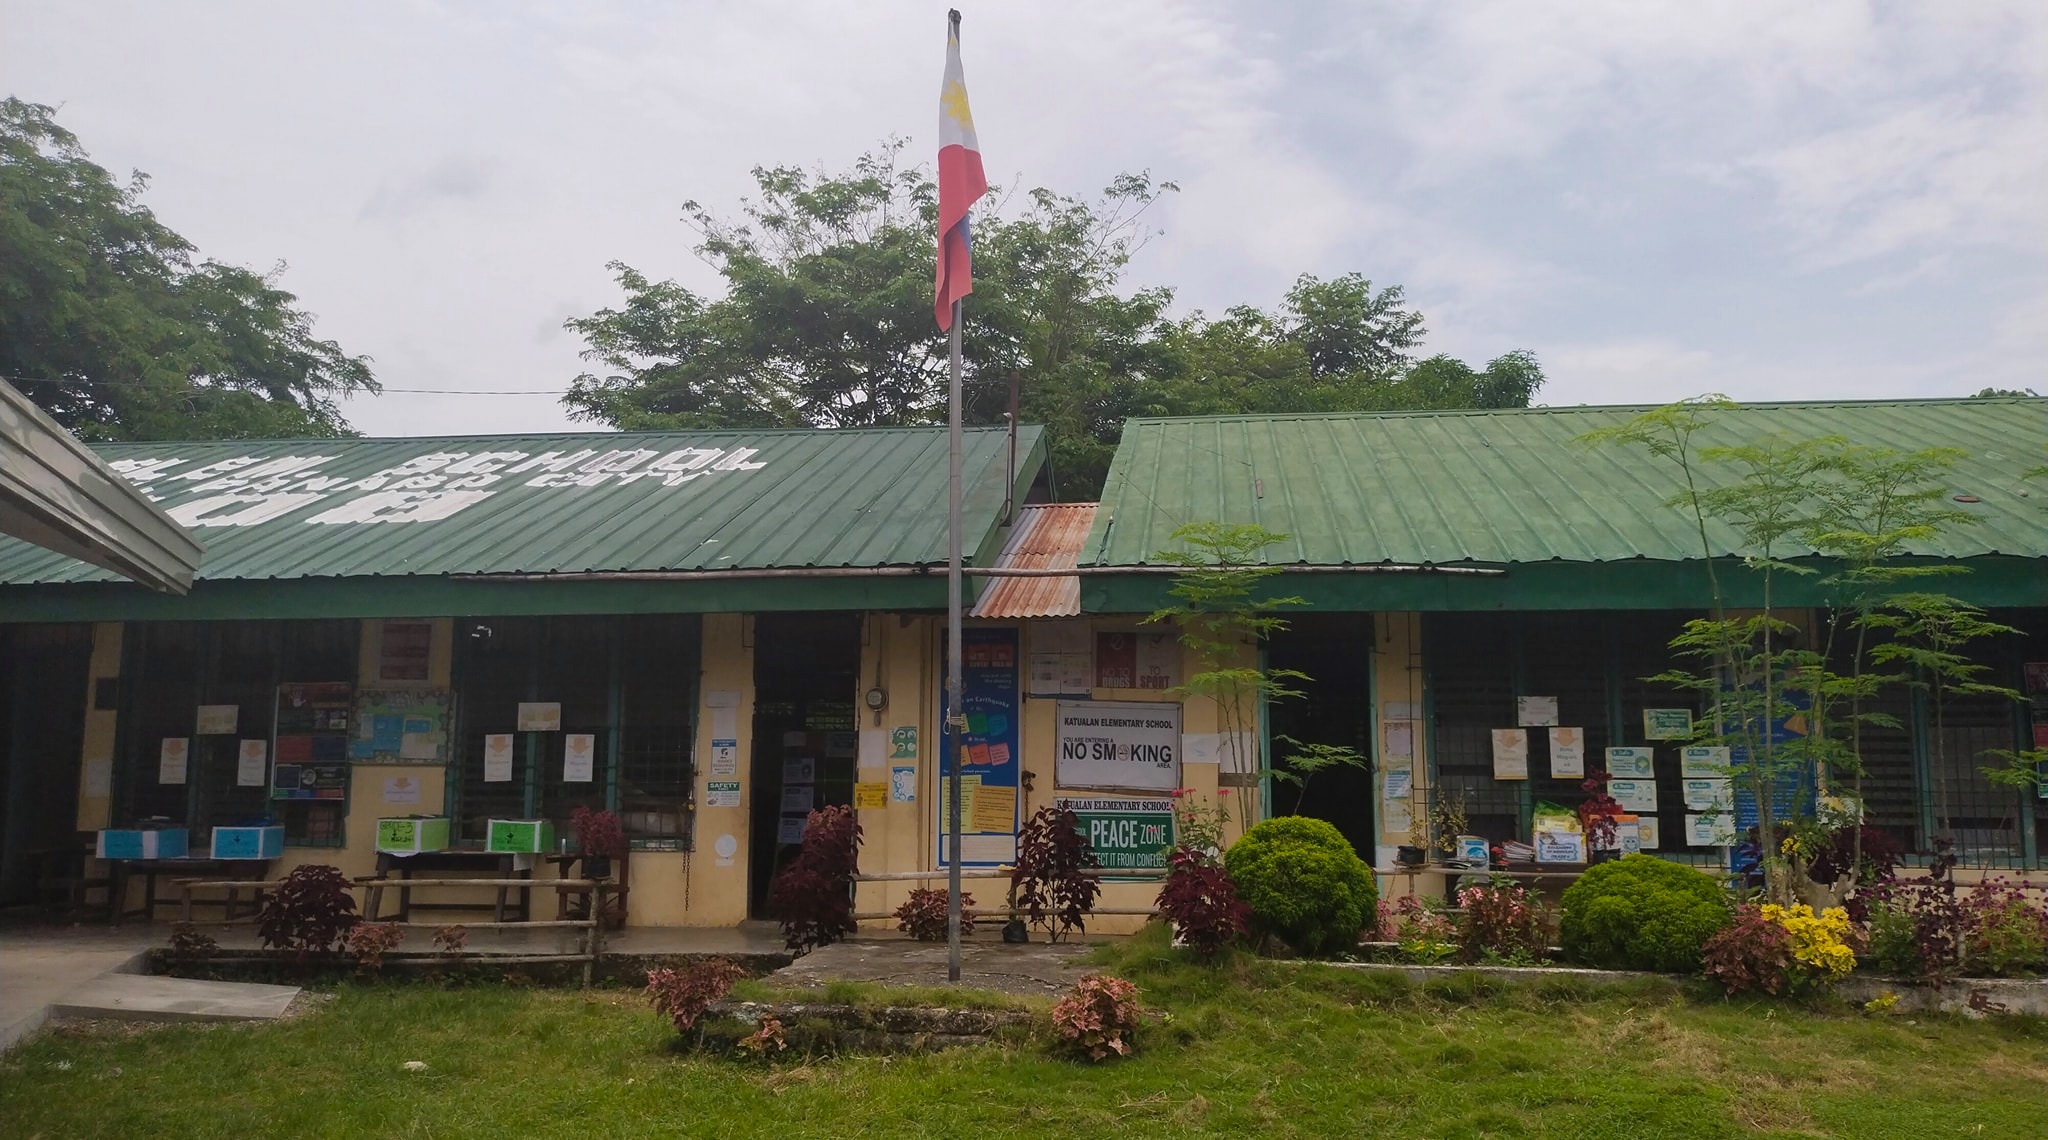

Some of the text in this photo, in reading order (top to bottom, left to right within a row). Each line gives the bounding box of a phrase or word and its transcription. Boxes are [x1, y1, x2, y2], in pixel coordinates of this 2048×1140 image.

[372, 447, 767, 476] SCHOOL
[1103, 677, 1130, 688] DRUGS
[1140, 675, 1170, 688] SPORT
[1064, 717, 1173, 729] KATUALAN ELEMENTARY SCHOOL
[1063, 743, 1087, 760] NO
[1094, 800, 1140, 811] ELEMENTARY
[1091, 819, 1138, 848] PEACE
[1140, 824, 1167, 845] ZONE
[1110, 853, 1116, 866] IT
[1117, 853, 1136, 867] FROM
